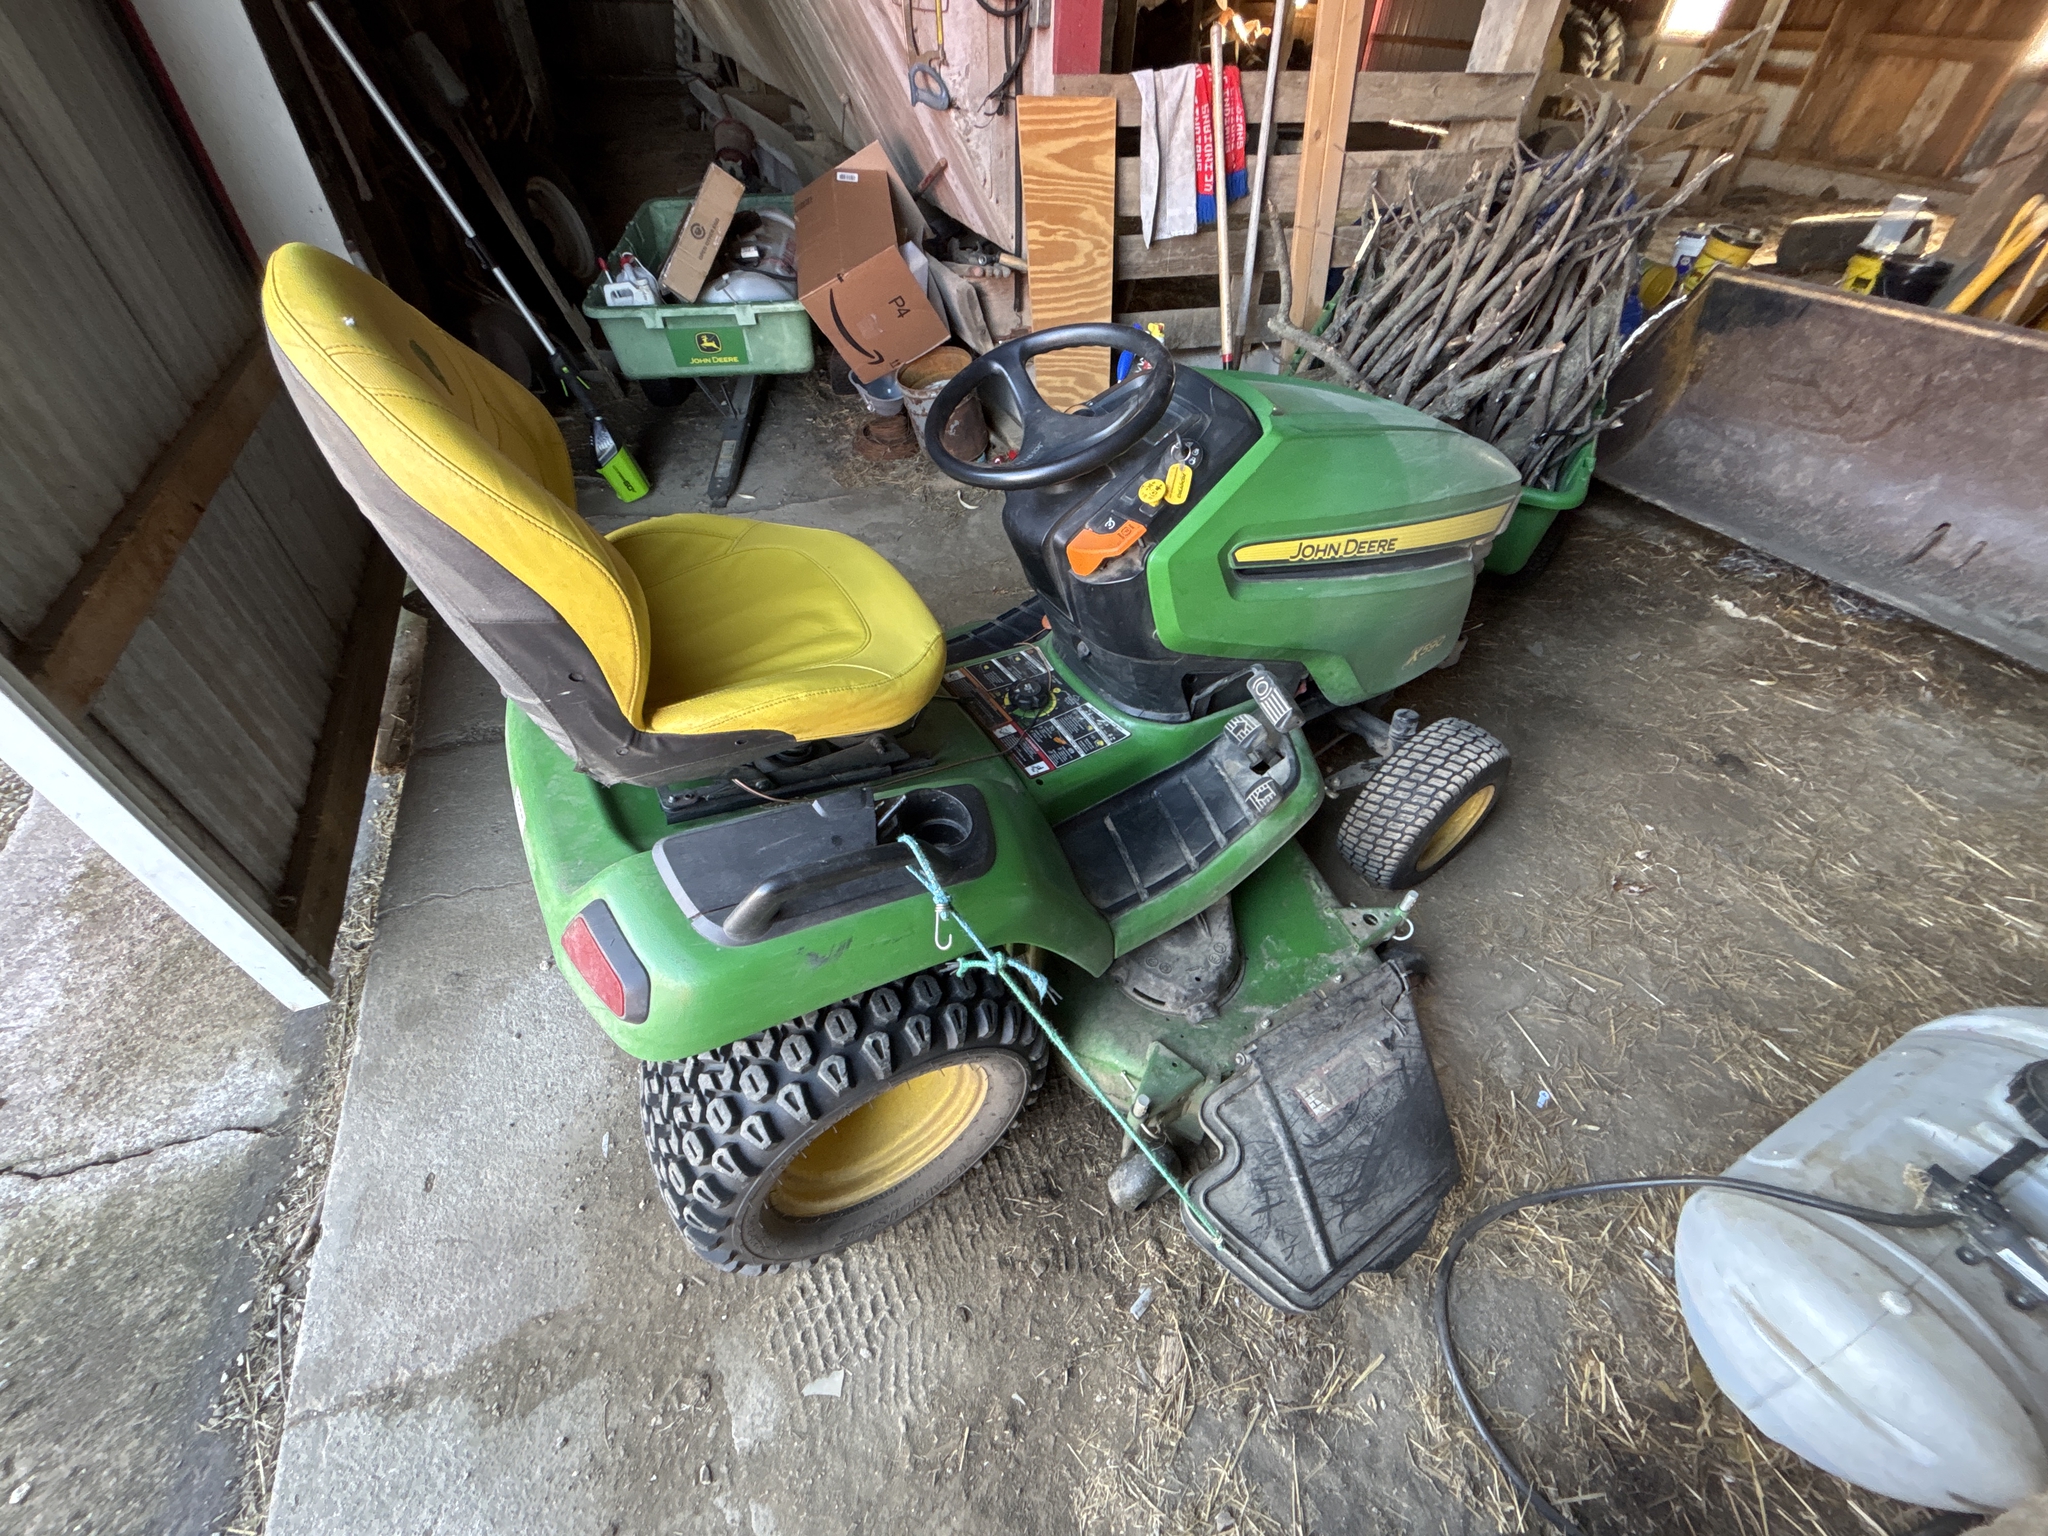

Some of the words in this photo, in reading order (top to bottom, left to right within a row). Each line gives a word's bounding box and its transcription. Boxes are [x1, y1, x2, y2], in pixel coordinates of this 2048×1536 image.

[1201, 103, 1214, 171] INDIANS
[888, 295, 911, 318] P4
[1289, 542, 1341, 559] JOHN
[1343, 538, 1398, 556] DEERE
